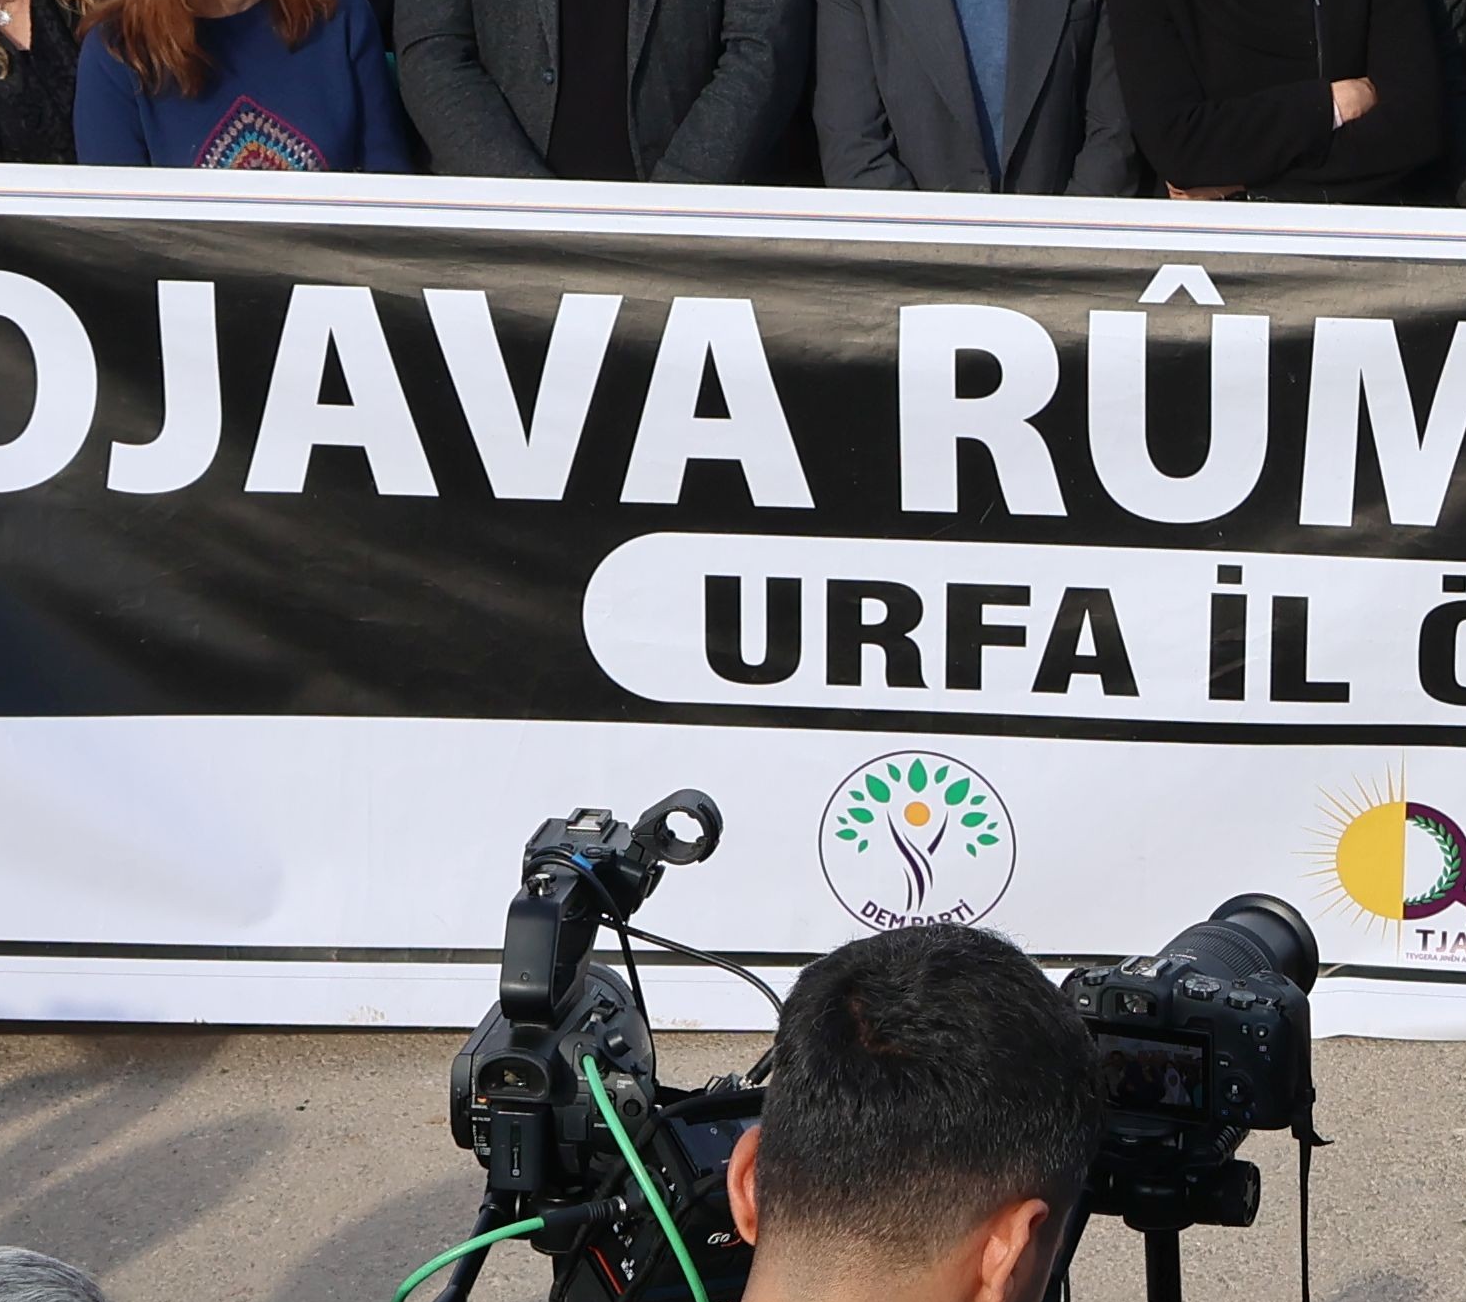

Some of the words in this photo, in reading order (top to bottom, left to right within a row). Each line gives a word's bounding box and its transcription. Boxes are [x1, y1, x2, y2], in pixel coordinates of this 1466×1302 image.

[704, 574, 1140, 699] URFA
[1207, 564, 1352, 704] İL
[860, 900, 906, 930] DEM
[1405, 951, 1438, 962] TEVGERA
